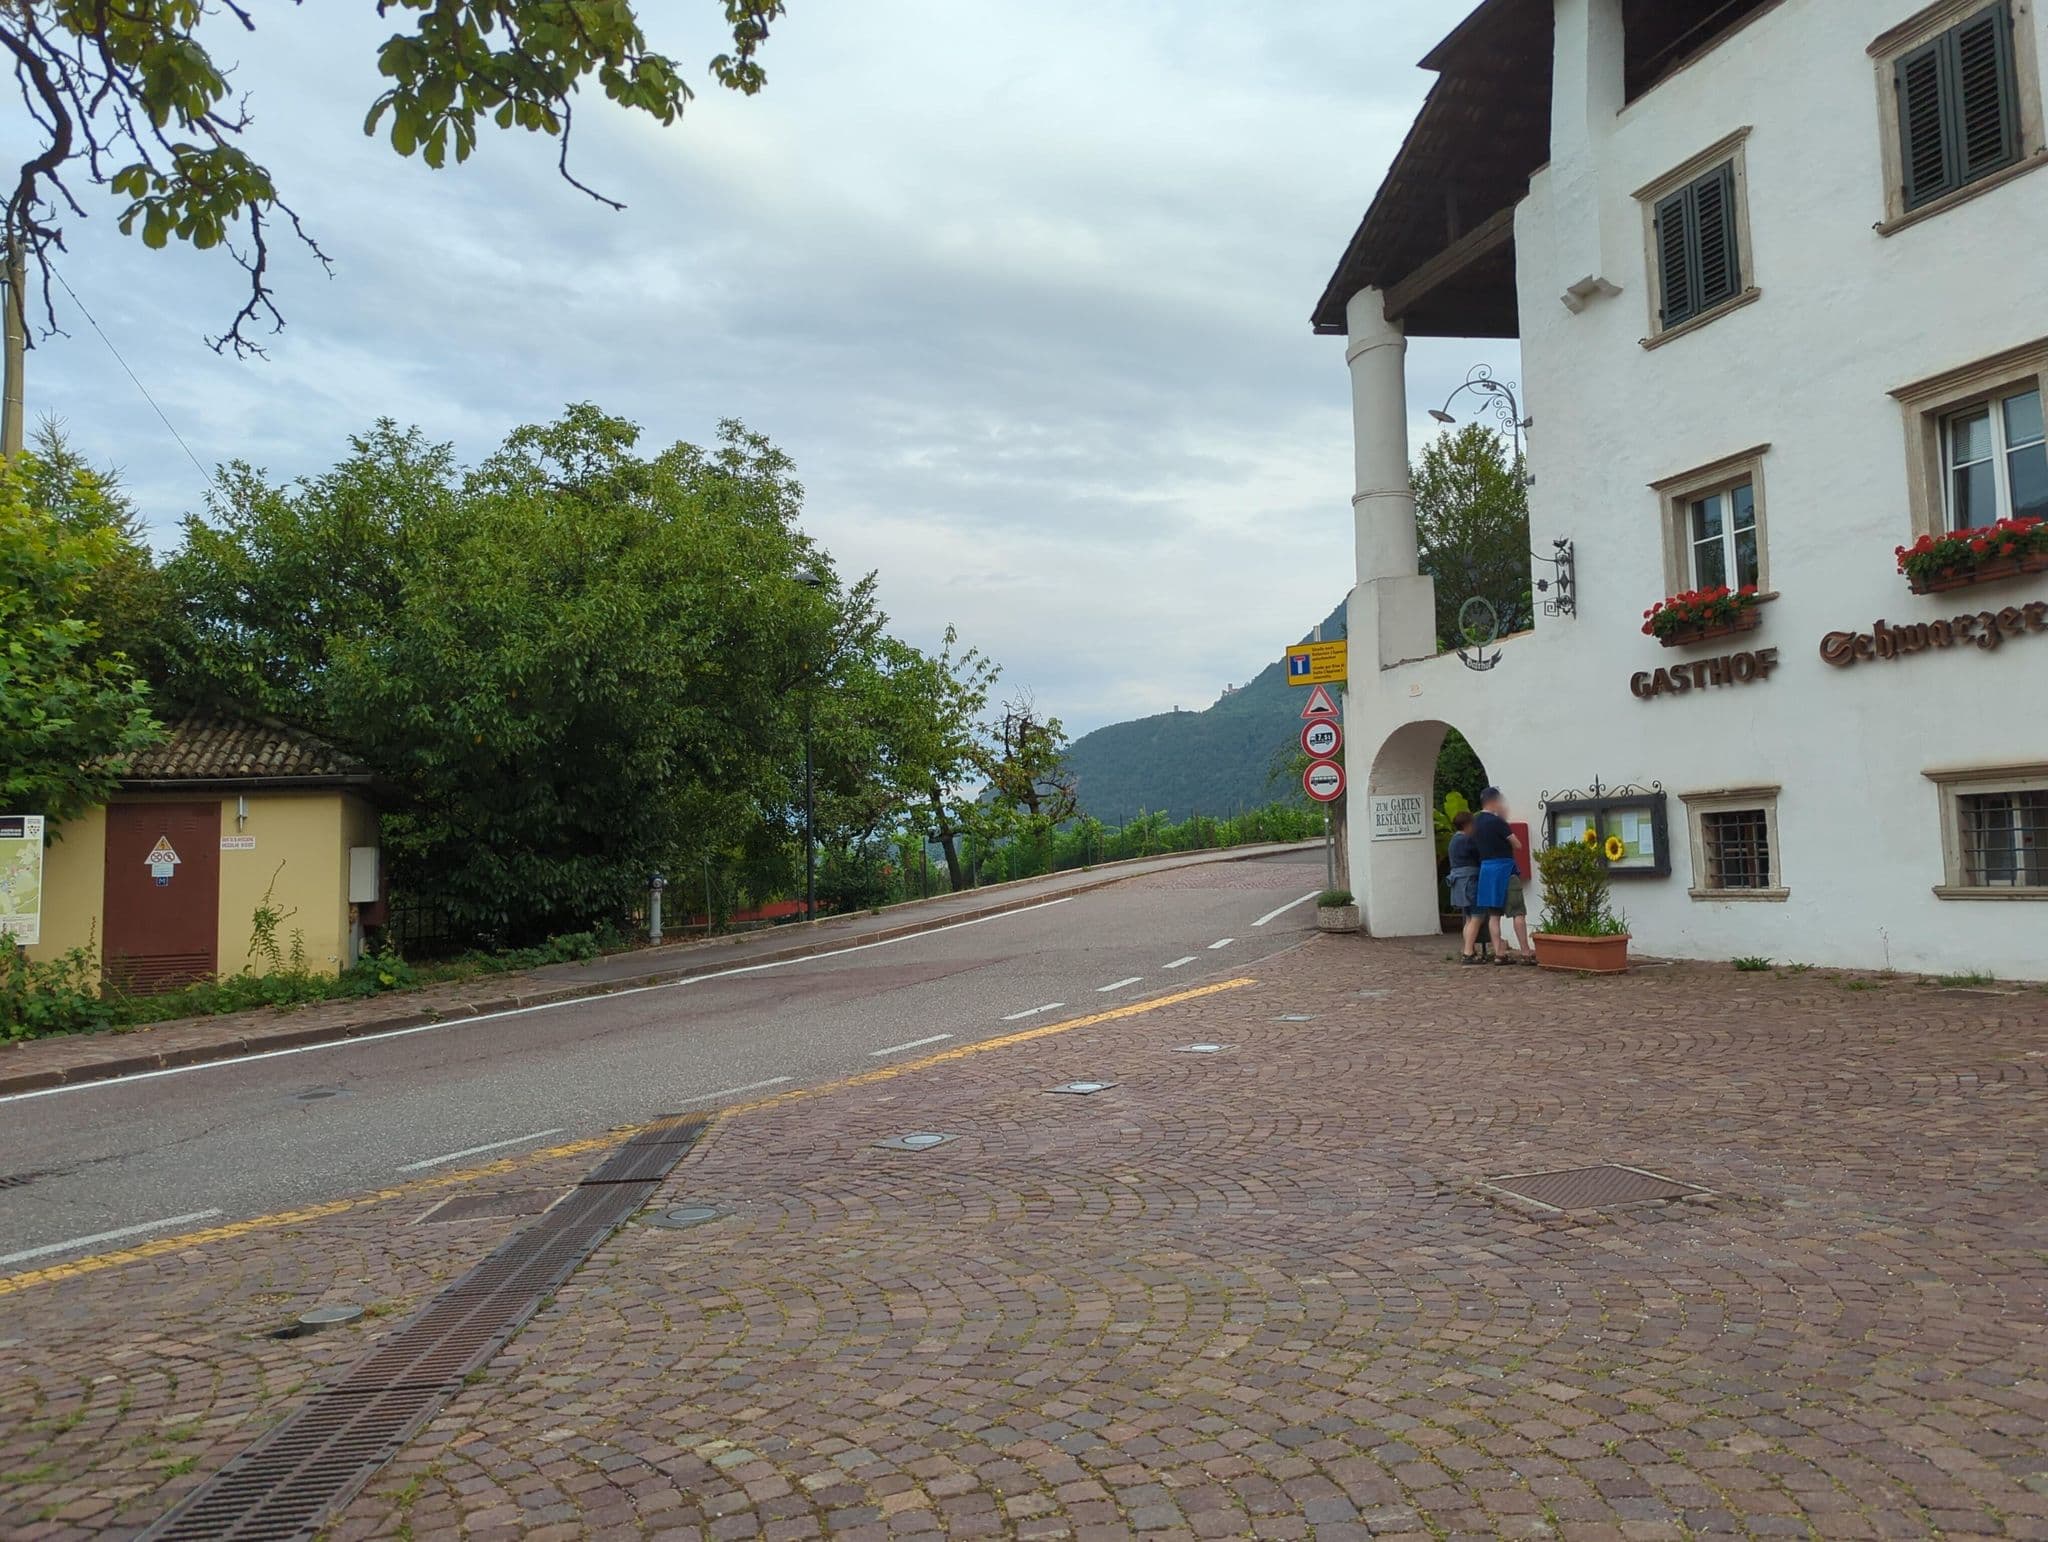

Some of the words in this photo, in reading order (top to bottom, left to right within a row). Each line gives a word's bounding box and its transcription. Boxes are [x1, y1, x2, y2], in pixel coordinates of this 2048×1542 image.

[1630, 647, 1777, 698] GASTHOF
[1820, 601, 2048, 665] Schwarzer
[1376, 802, 1388, 811] ZUM
[1391, 797, 1421, 811] GARTEN
[1376, 812, 1421, 826] RESTAURANT
